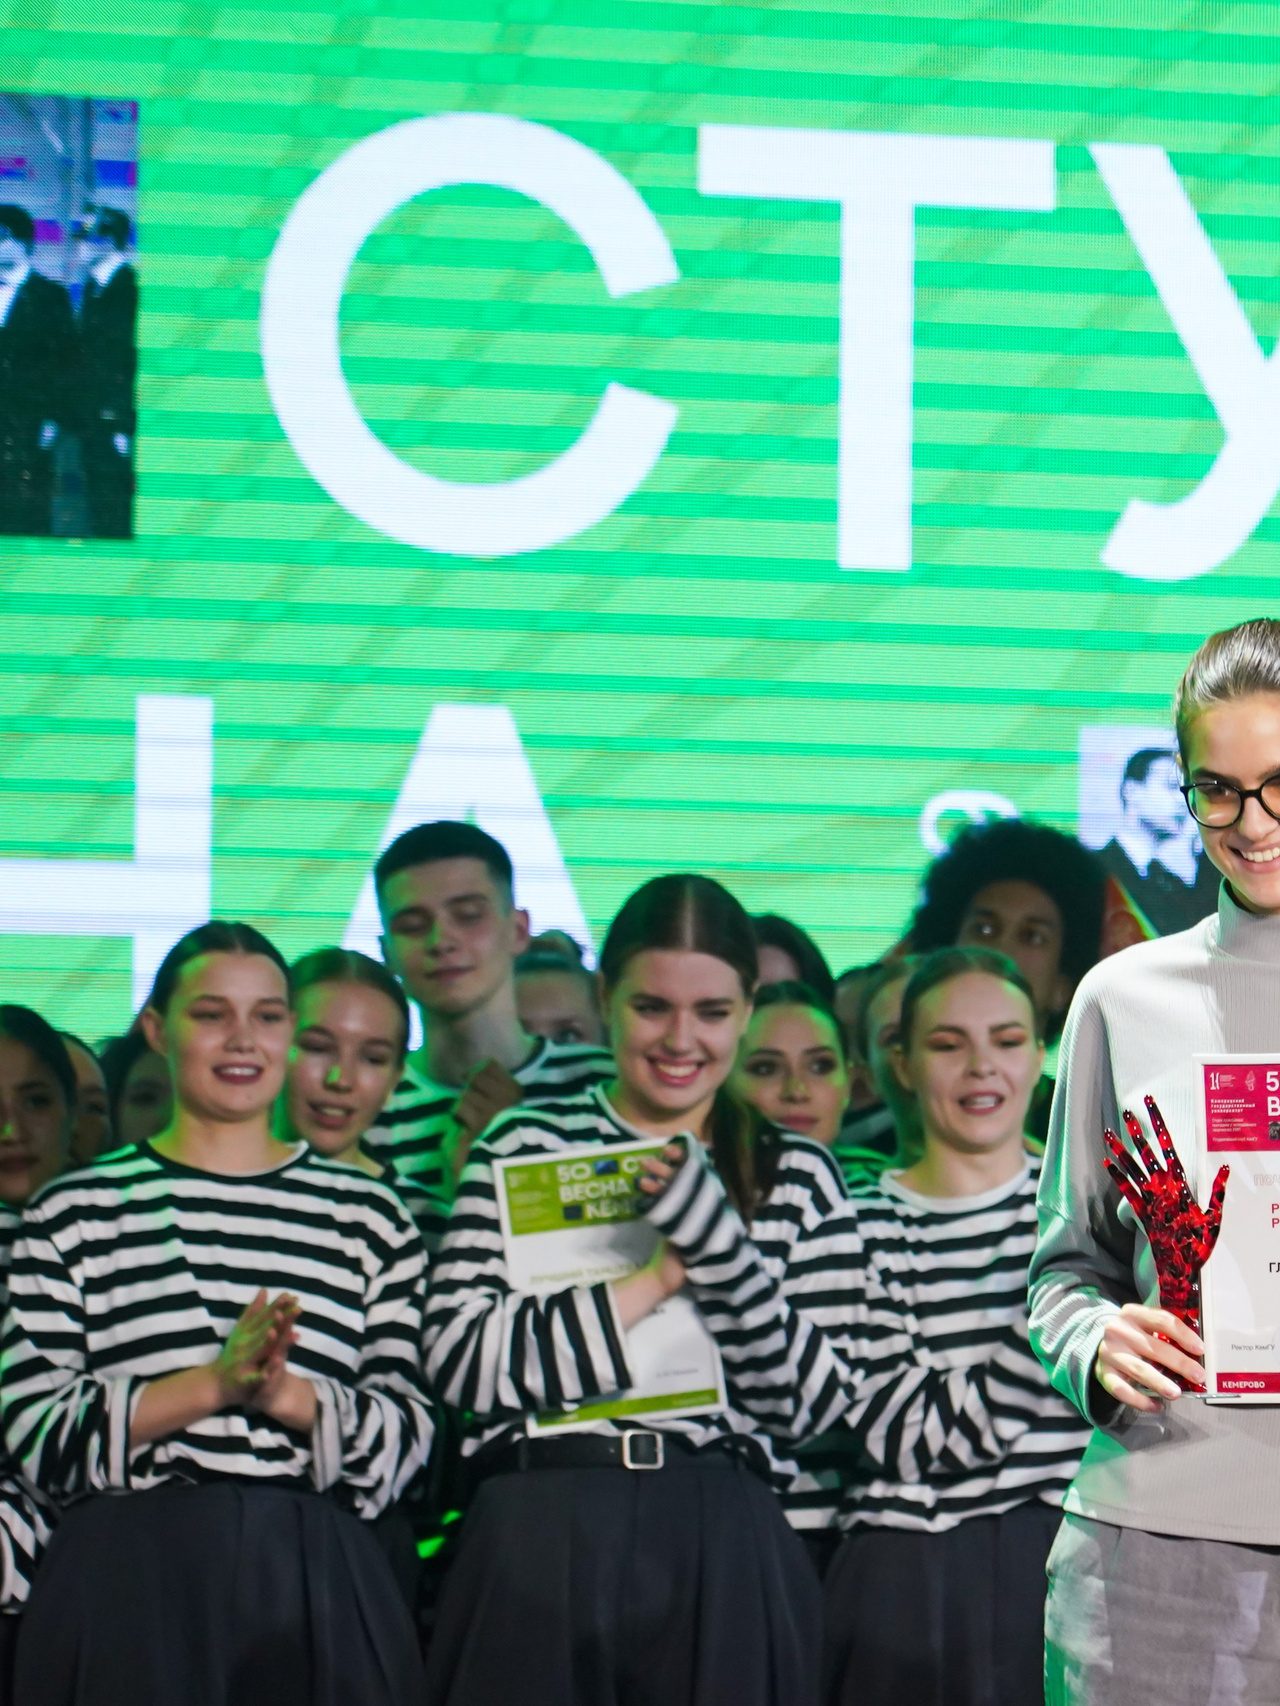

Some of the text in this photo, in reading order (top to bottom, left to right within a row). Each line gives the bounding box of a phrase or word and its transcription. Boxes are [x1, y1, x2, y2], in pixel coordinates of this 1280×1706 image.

[559, 1178, 630, 1203] ВЕСНА
[1231, 1343, 1276, 1351] Ректор КемГУ
[1222, 1380, 1266, 1389] КЕМЕРОВО
